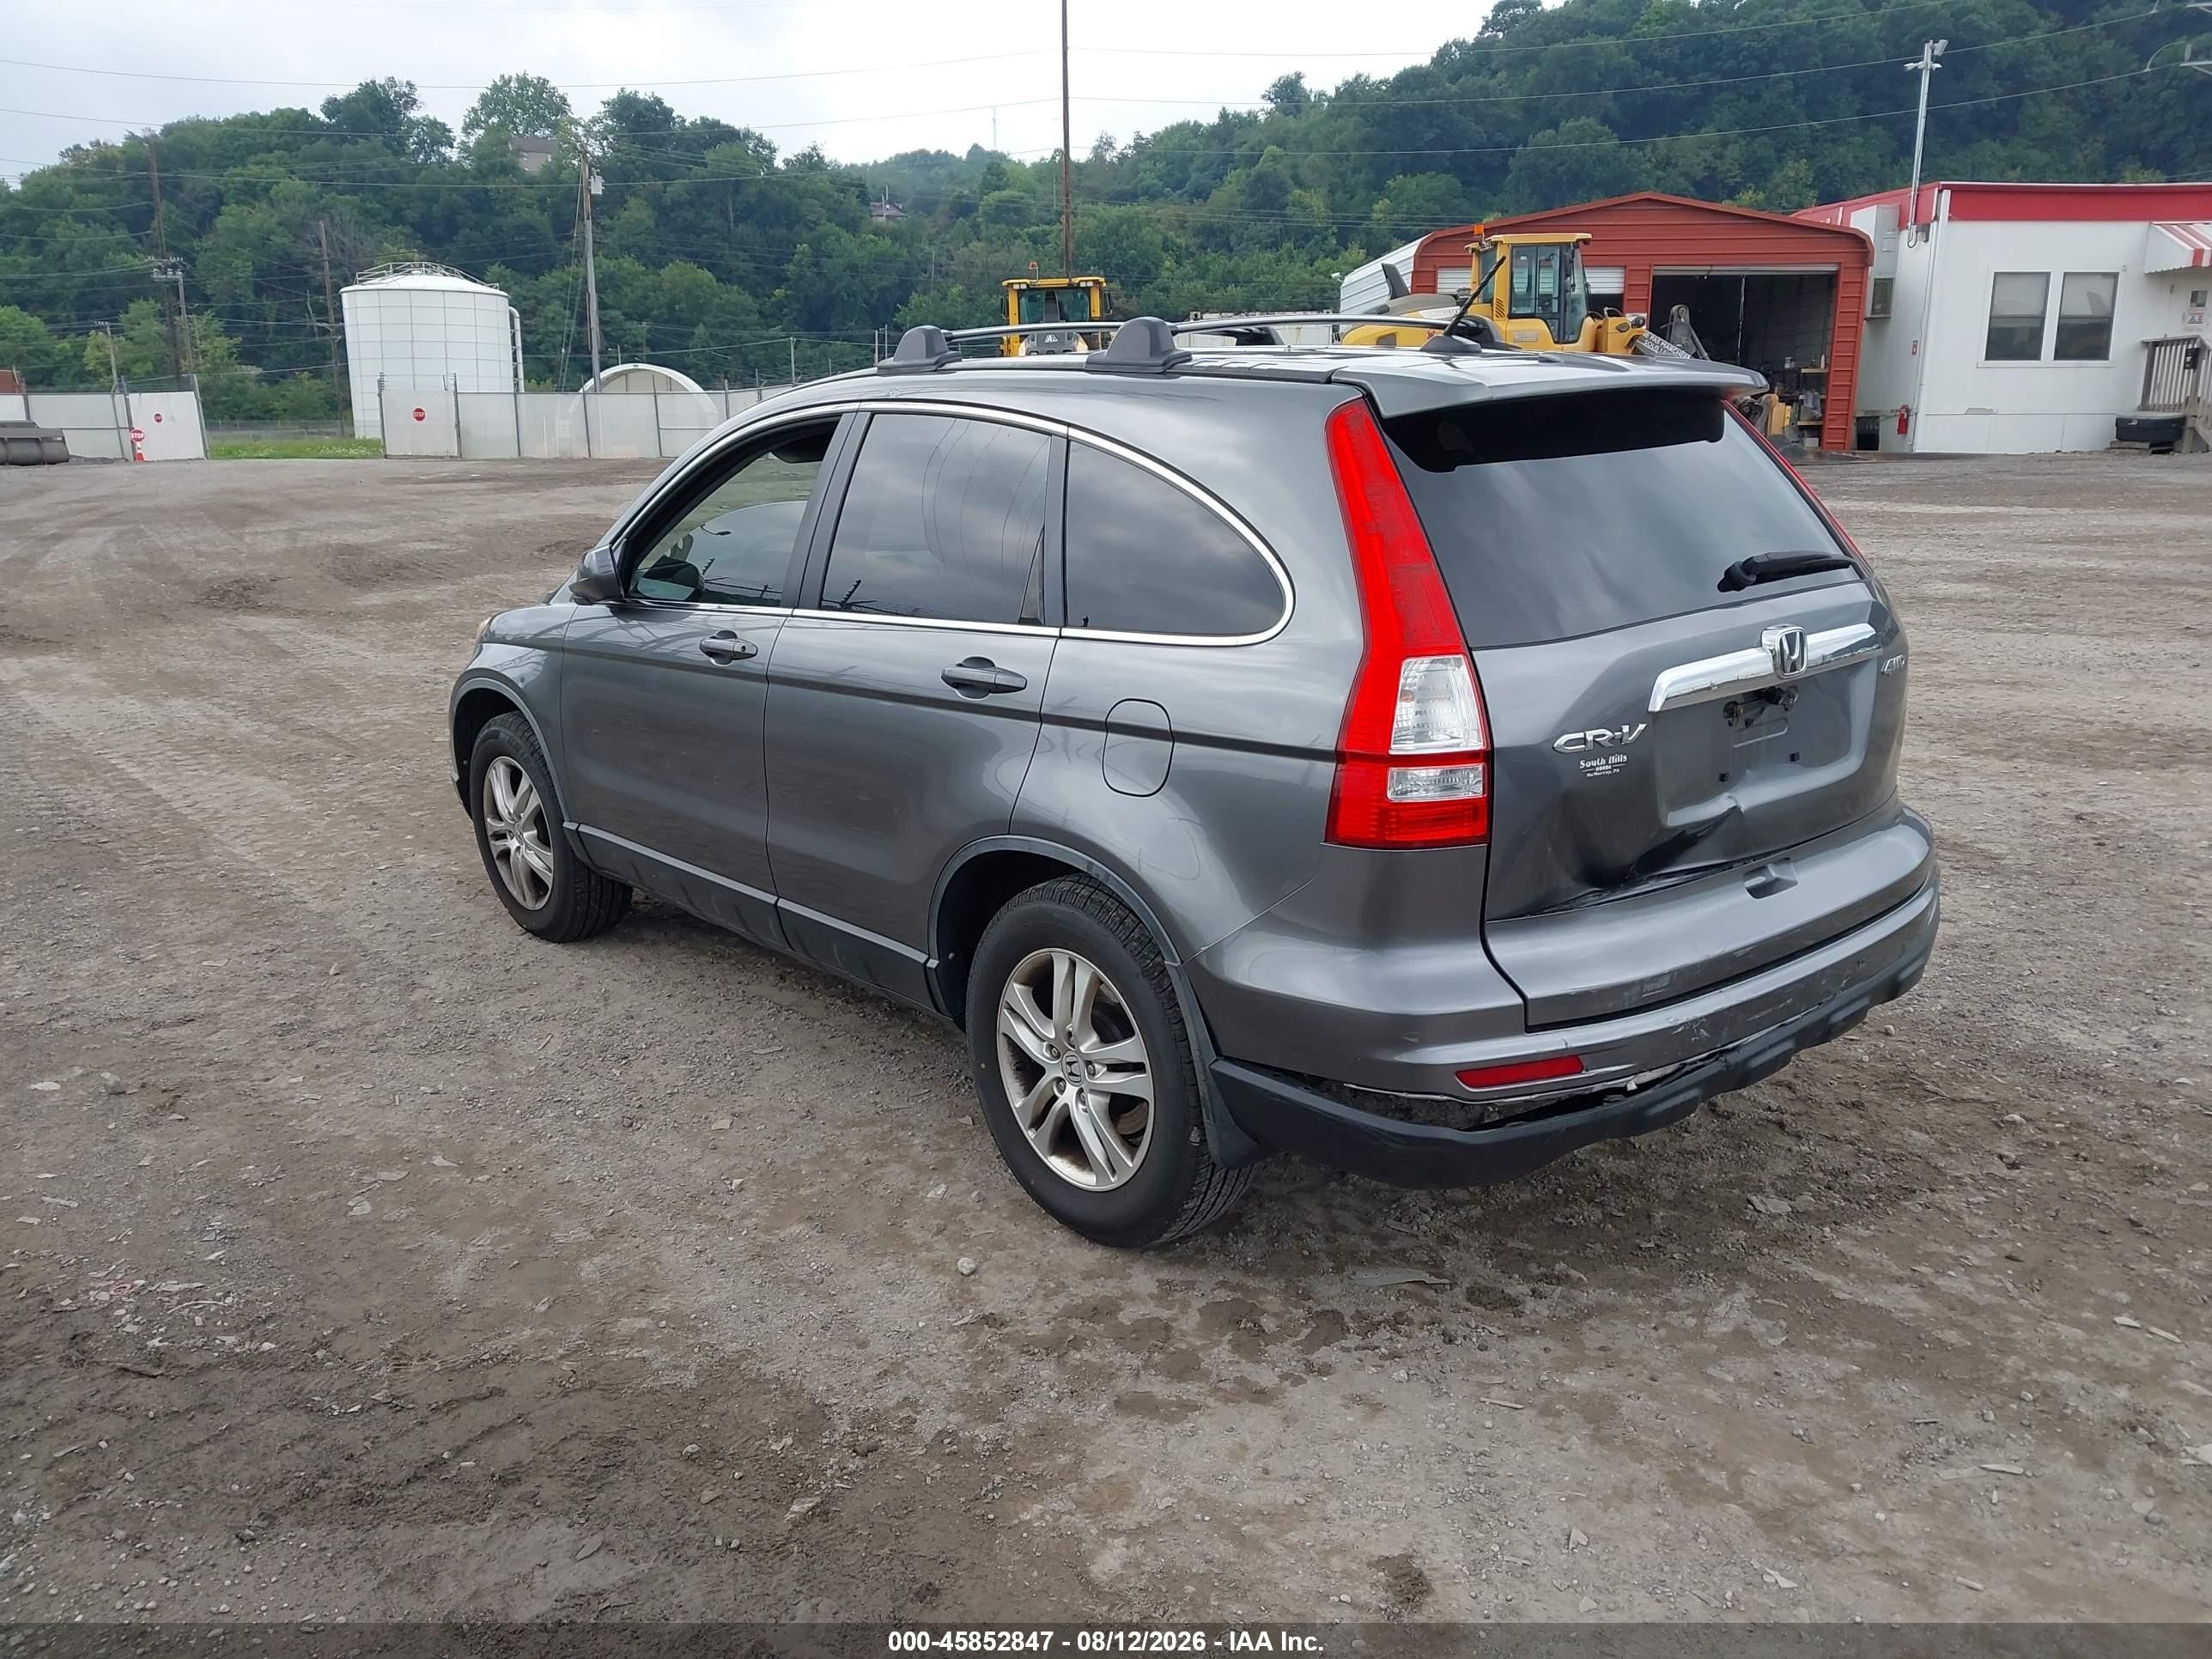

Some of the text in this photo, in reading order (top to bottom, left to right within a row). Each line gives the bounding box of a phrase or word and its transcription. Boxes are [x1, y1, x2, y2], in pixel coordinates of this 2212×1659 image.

[1553, 723, 1647, 753] CR-V
[1580, 754, 1627, 769] South Hills
